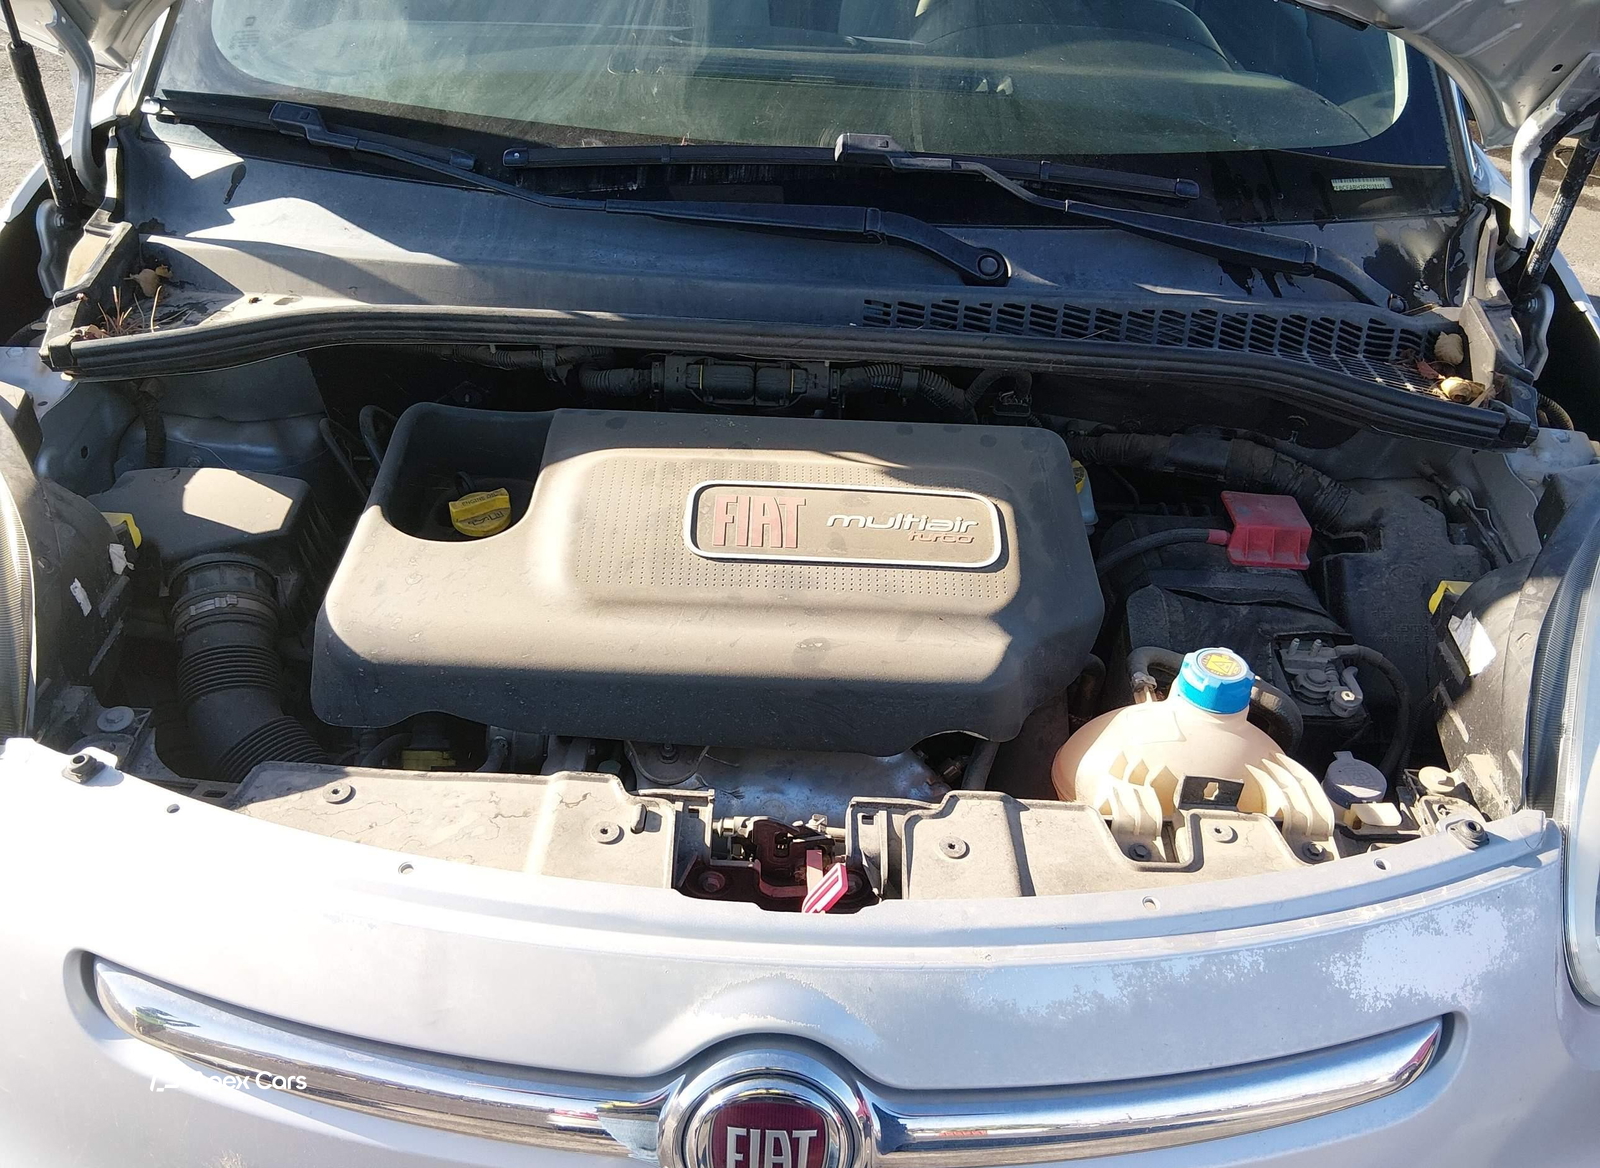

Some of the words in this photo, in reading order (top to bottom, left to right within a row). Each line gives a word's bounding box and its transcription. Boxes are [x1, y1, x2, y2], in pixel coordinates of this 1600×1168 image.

[712, 495, 806, 549] FIAT
[826, 512, 979, 534] multiair
[726, 1126, 818, 1168] FIAT
